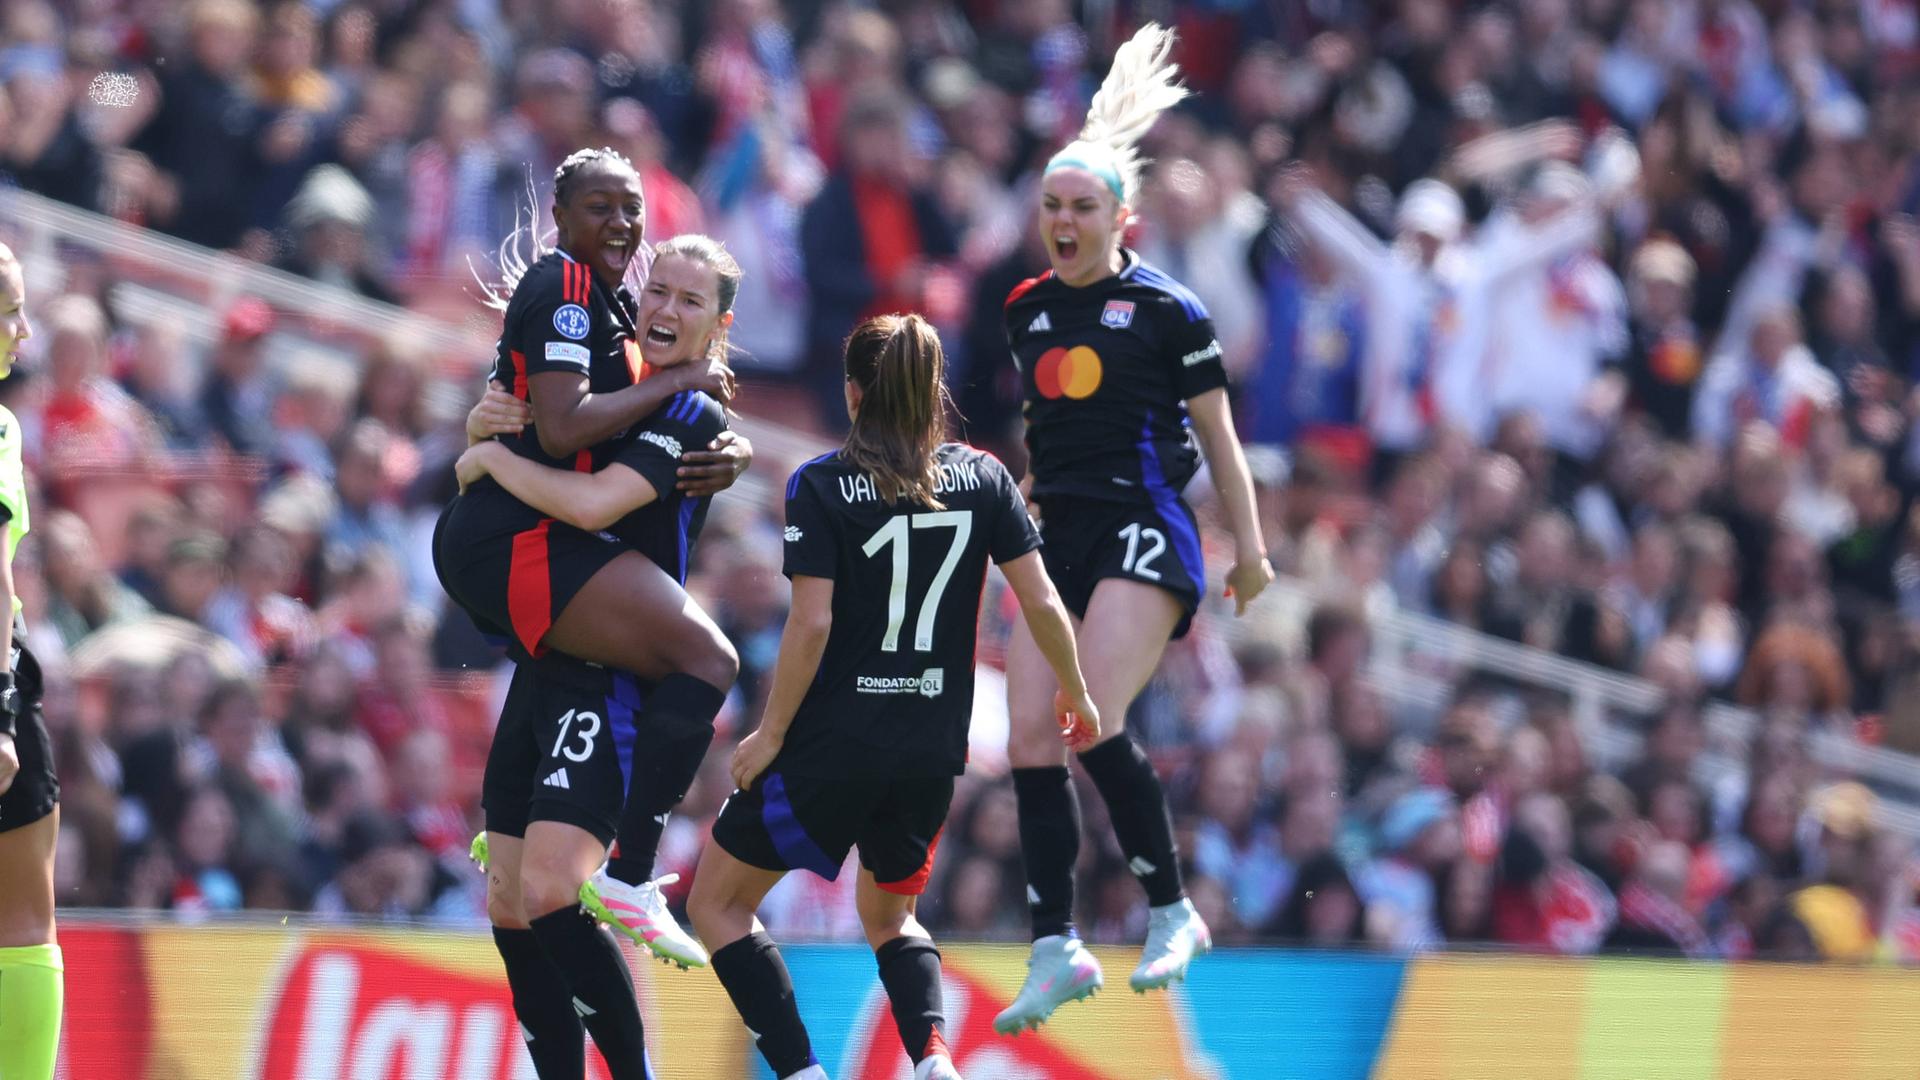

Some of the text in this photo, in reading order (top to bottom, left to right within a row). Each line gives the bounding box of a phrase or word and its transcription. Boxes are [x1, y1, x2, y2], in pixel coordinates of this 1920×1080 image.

[569, 314, 578, 328] 8
[1118, 522, 1167, 581] 12
[861, 510, 973, 652] 17
[857, 676, 921, 688] FONDATION
[922, 679, 940, 692] OL
[551, 707, 601, 763] 13
